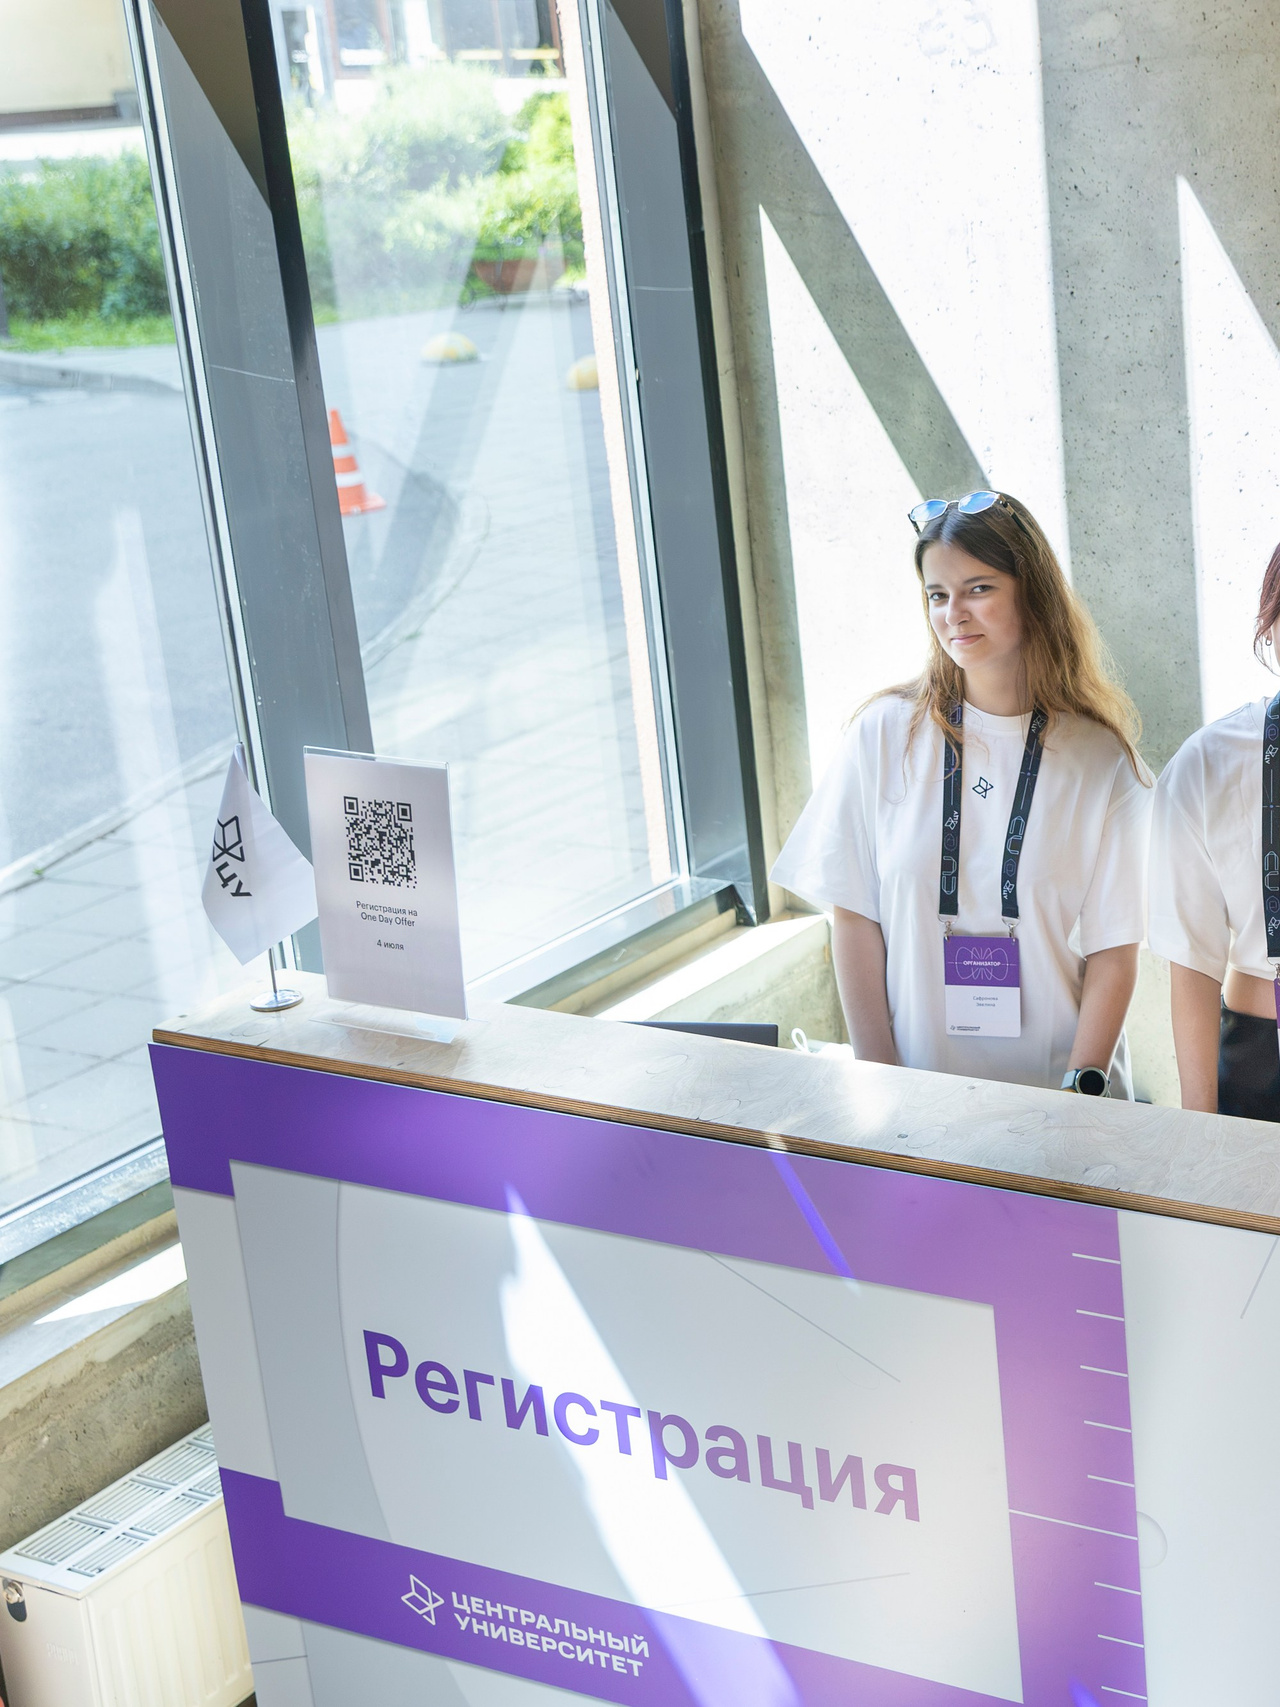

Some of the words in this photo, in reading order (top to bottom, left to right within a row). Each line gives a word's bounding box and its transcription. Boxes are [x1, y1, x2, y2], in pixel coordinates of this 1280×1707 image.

[215, 861, 252, 897] ЦУ
[356, 900, 406, 915] Регистрация
[408, 909, 418, 917] на
[360, 911, 377, 922] One
[378, 914, 393, 926] Day
[394, 916, 415, 927] Offer
[376, 939, 382, 947] 4
[383, 941, 404, 951] июля
[363, 1329, 920, 1523] Регистрация
[451, 1591, 650, 1658] ЦЕНТРАЛЬНЫЙ
[454, 1613, 643, 1677] УНИВЕРСИТЕТ
